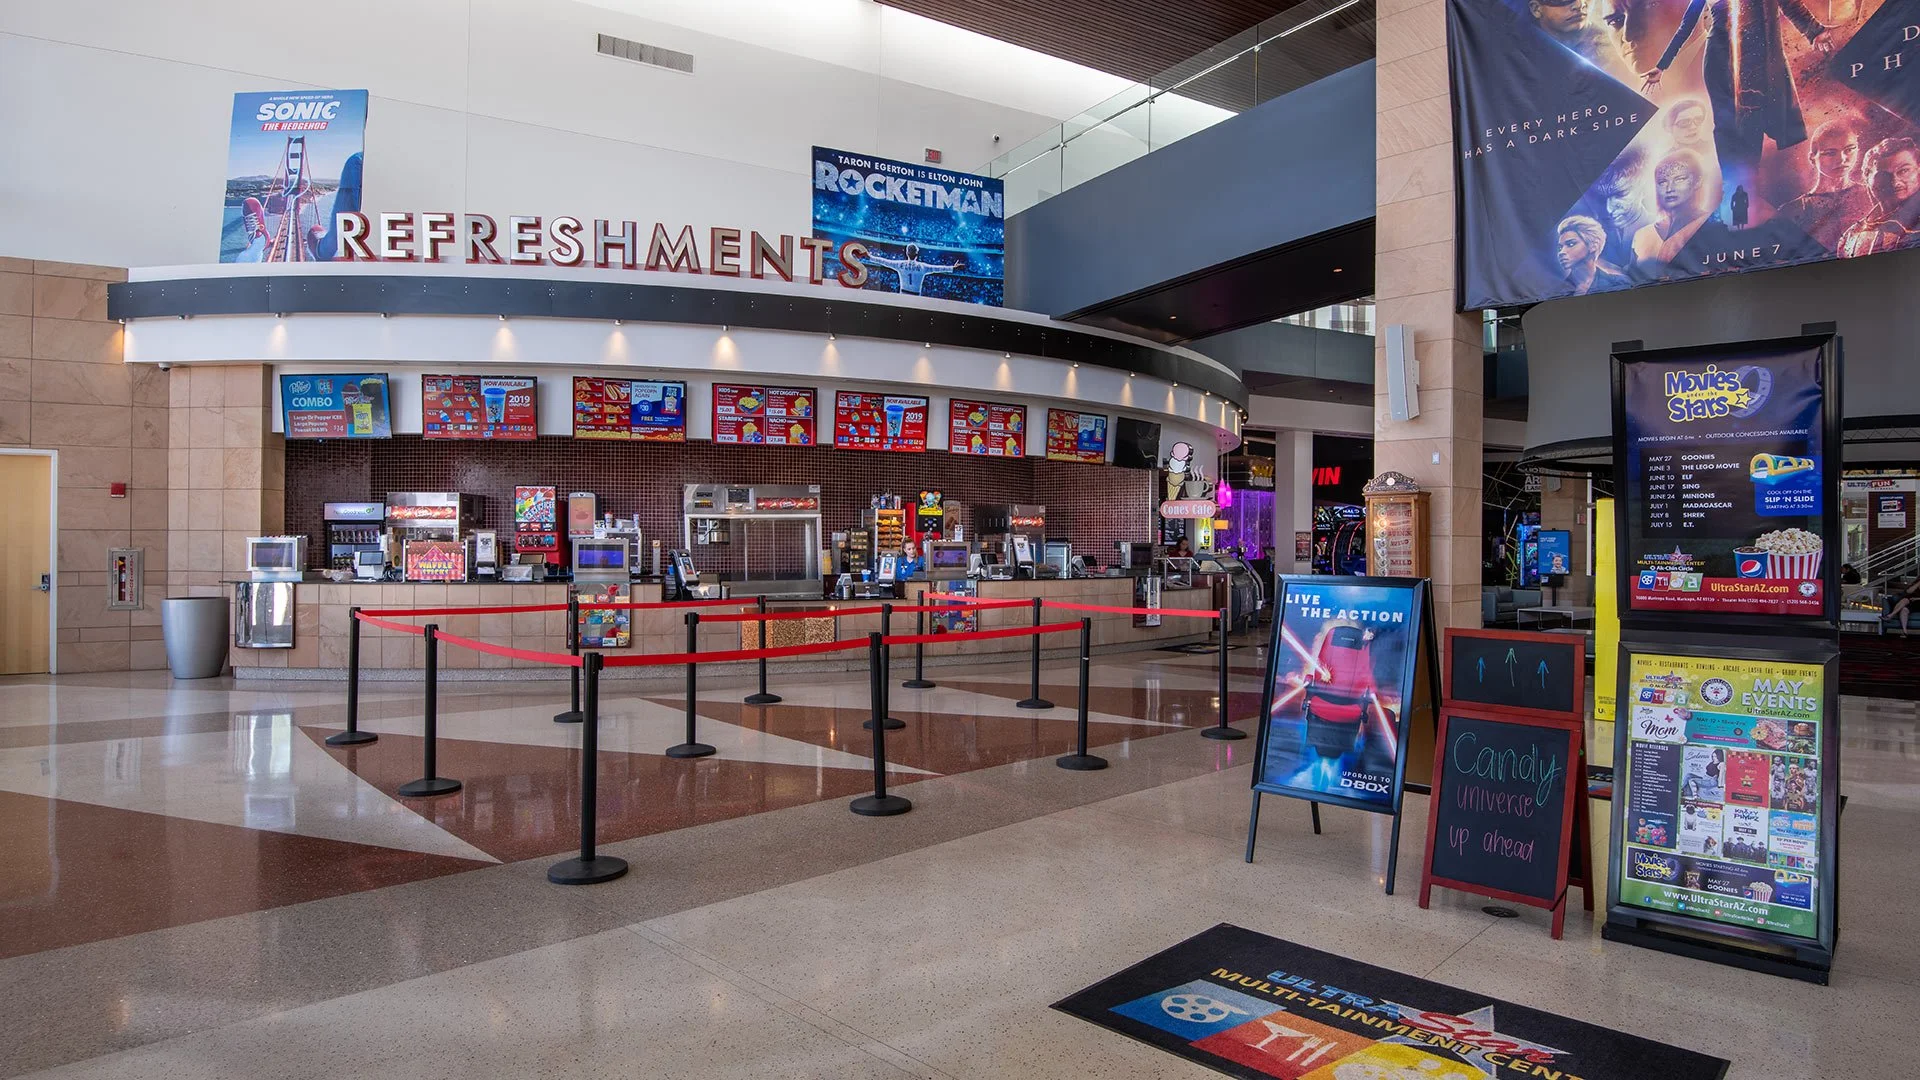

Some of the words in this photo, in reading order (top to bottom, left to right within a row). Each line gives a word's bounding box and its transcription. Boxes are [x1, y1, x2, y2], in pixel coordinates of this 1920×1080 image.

[256, 101, 340, 120] SONIC
[264, 122, 280, 130] THE
[280, 122, 327, 130] HEDGEHOG
[1486, 118, 1543, 138] EVERY
[1557, 104, 1608, 123] HERO
[1464, 143, 1493, 160] HAS
[1506, 140, 1515, 148] A
[1529, 127, 1578, 144] DARK
[1592, 113, 1638, 131] SIDE
[838, 155, 871, 169] TARON
[874, 162, 915, 177] EGERTON
[918, 170, 926, 179] IS
[928, 172, 956, 184] ELTON
[958, 177, 984, 188] JOHN
[815, 160, 1003, 218] ROCKETMAN
[336, 210, 870, 290] REFRESHMENTS
[1702, 248, 1762, 265] JUNE
[1772, 244, 1782, 256] 7
[1665, 364, 1740, 396] Movies
[292, 397, 332, 407] COMBO
[1668, 396, 1730, 422] Stars
[1735, 430, 1778, 438] CONCESSIONS
[1163, 504, 1189, 514] Cones
[1192, 504, 1212, 514] Cafe
[1710, 583, 1789, 593] UltraStarAZ.com
[1286, 594, 1320, 605] LIVE
[1301, 608, 1331, 619] THE
[1337, 610, 1404, 623] ACTION
[1659, 660, 1689, 668] RESTAURANTS
[1753, 678, 1804, 695] MAY
[1742, 692, 1817, 712] EVENTS
[1747, 708, 1810, 718] UltraStarAZ.com
[1640, 719, 1679, 739] Mom
[1342, 770, 1378, 782] UPGRADE
[1454, 732, 1562, 807] Candy
[1456, 784, 1534, 818] universe
[1450, 825, 1470, 856] up
[1483, 829, 1535, 863] ahead
[1635, 852, 1668, 868] Movies
[1636, 864, 1662, 878] Stars
[1707, 884, 1738, 894] GOONIES
[1663, 890, 1768, 915] www.UltraStarAZ.com
[1210, 967, 1483, 1056] MULTI-TAINMENT
[1266, 969, 1401, 1022] ULTRA
[1400, 1011, 1557, 1065] Star
